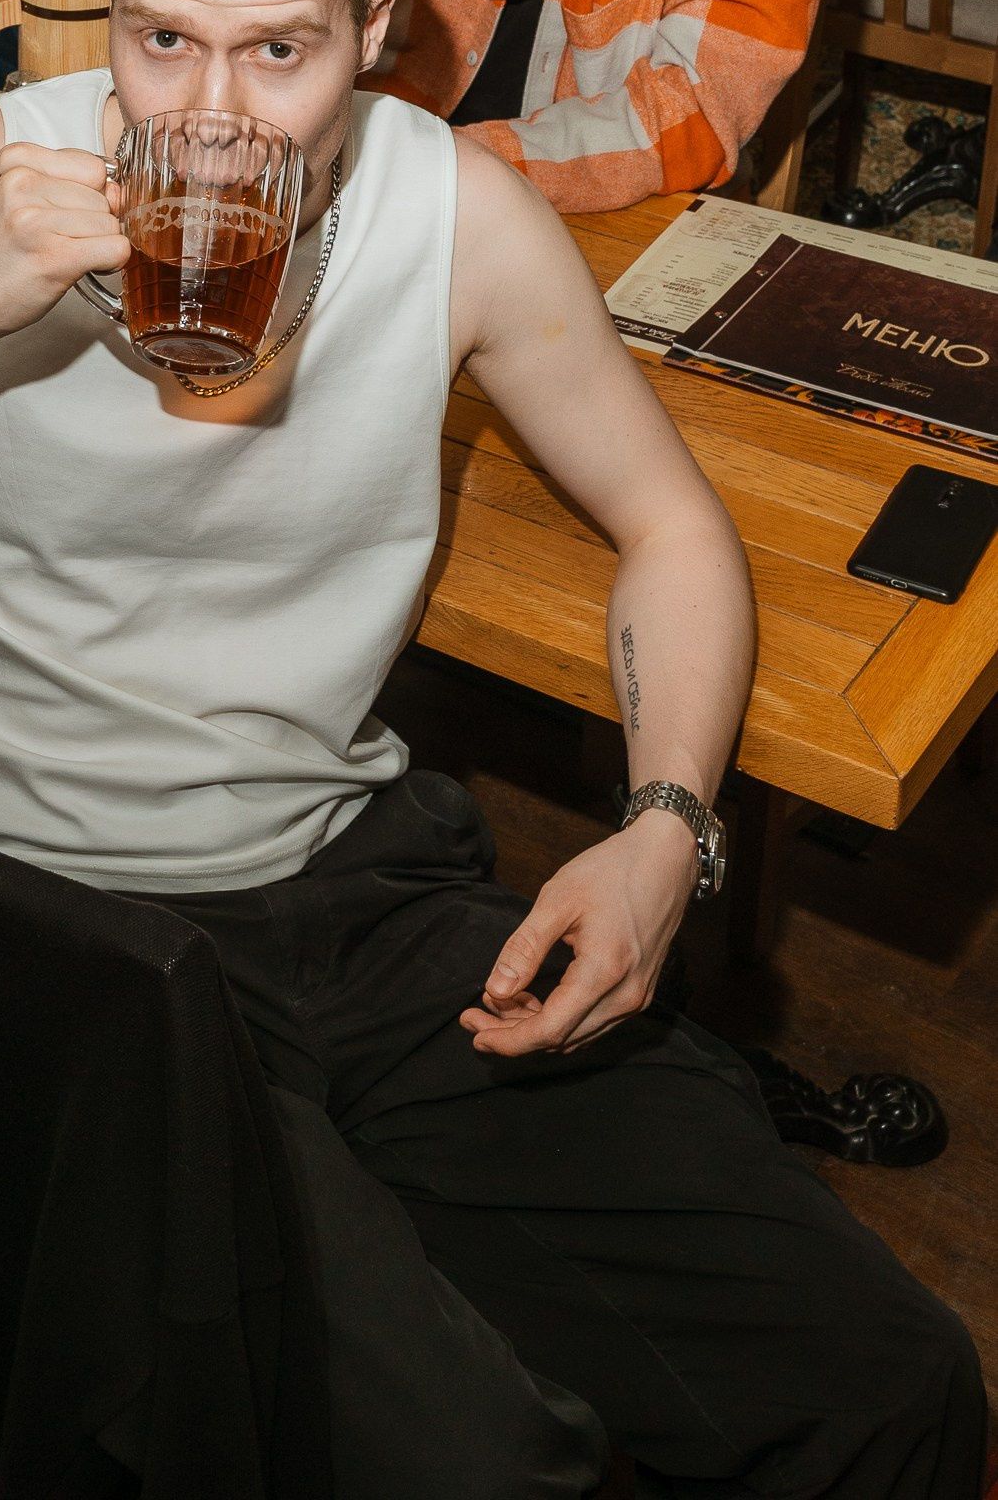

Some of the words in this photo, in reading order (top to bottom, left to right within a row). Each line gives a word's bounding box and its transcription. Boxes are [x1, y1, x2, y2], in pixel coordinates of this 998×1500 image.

[841, 312, 990, 367] МЕНЮ
[620, 623, 634, 670] ЗДЕСЬ
[626, 668, 636, 682] И
[627, 681, 641, 738] СЕЙЧАС
